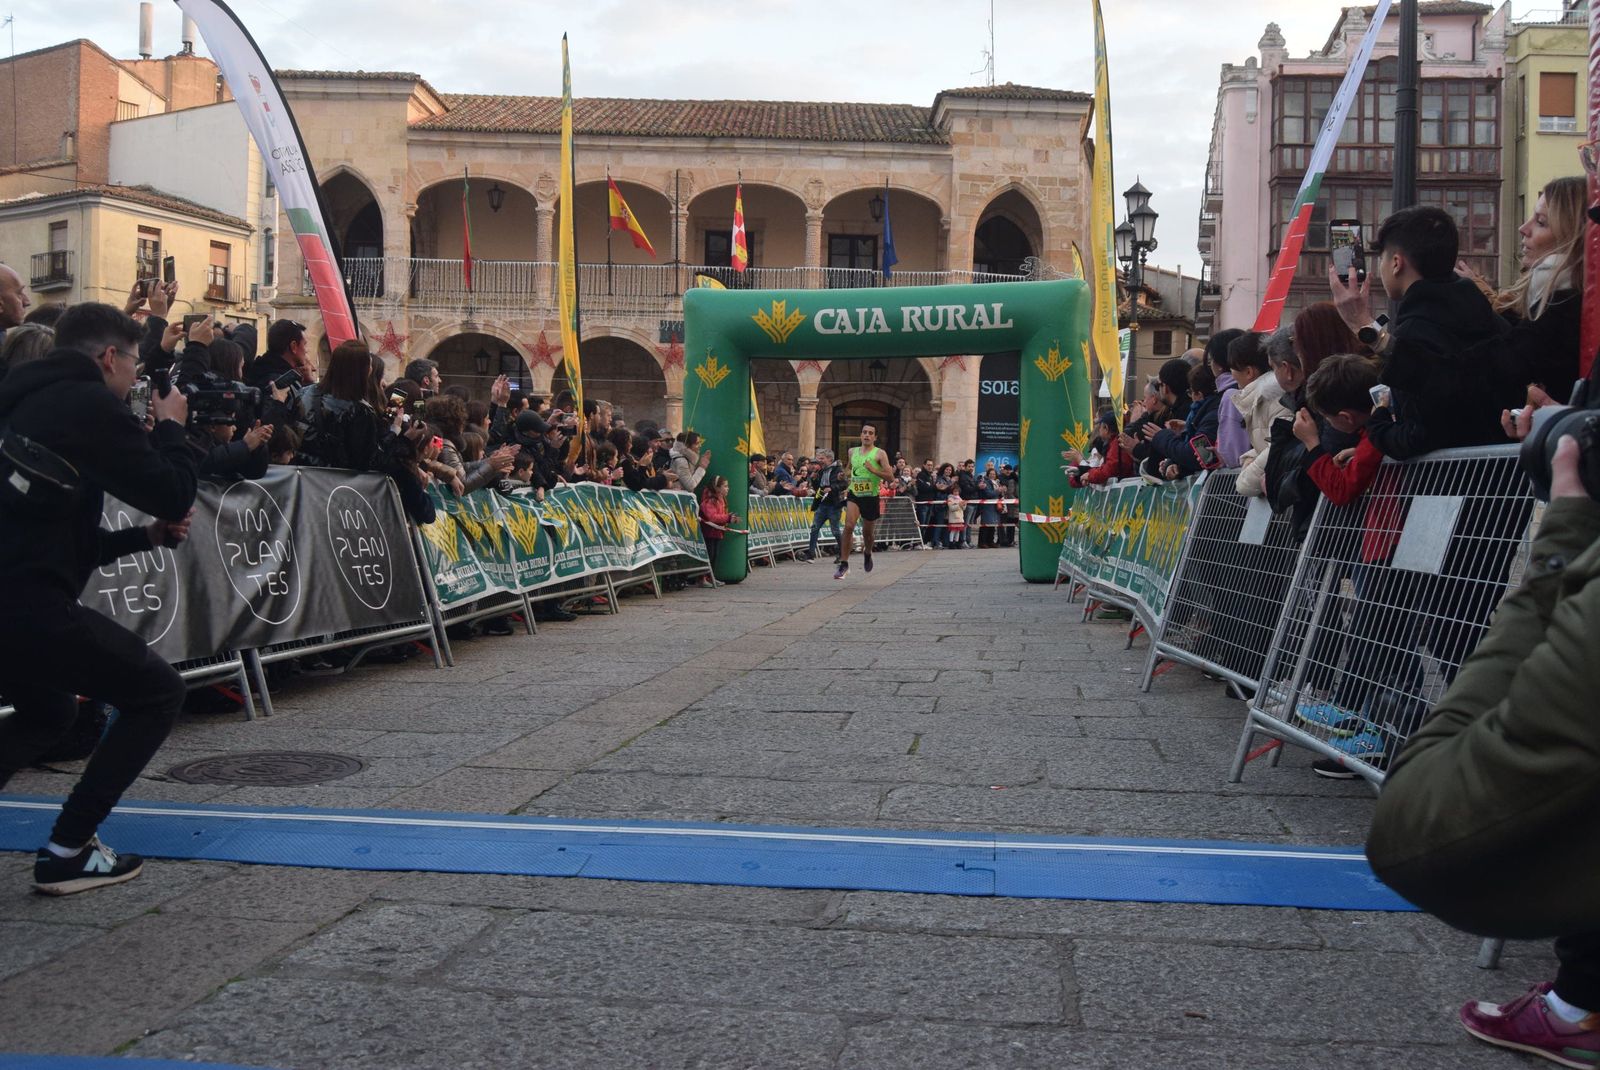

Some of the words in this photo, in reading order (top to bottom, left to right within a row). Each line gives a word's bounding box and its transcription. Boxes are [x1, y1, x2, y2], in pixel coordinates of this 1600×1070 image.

[813, 308, 892, 335] CAJA
[900, 303, 1014, 332] RURAL
[854, 482, 870, 492] 854
[236, 508, 272, 532] IM
[338, 509, 368, 530] IM
[225, 539, 292, 567] PLAN
[336, 536, 385, 558] PLAN
[529, 556, 550, 570] RURAL
[247, 571, 289, 597] TES
[352, 564, 385, 586] TES
[99, 583, 163, 616] TES
